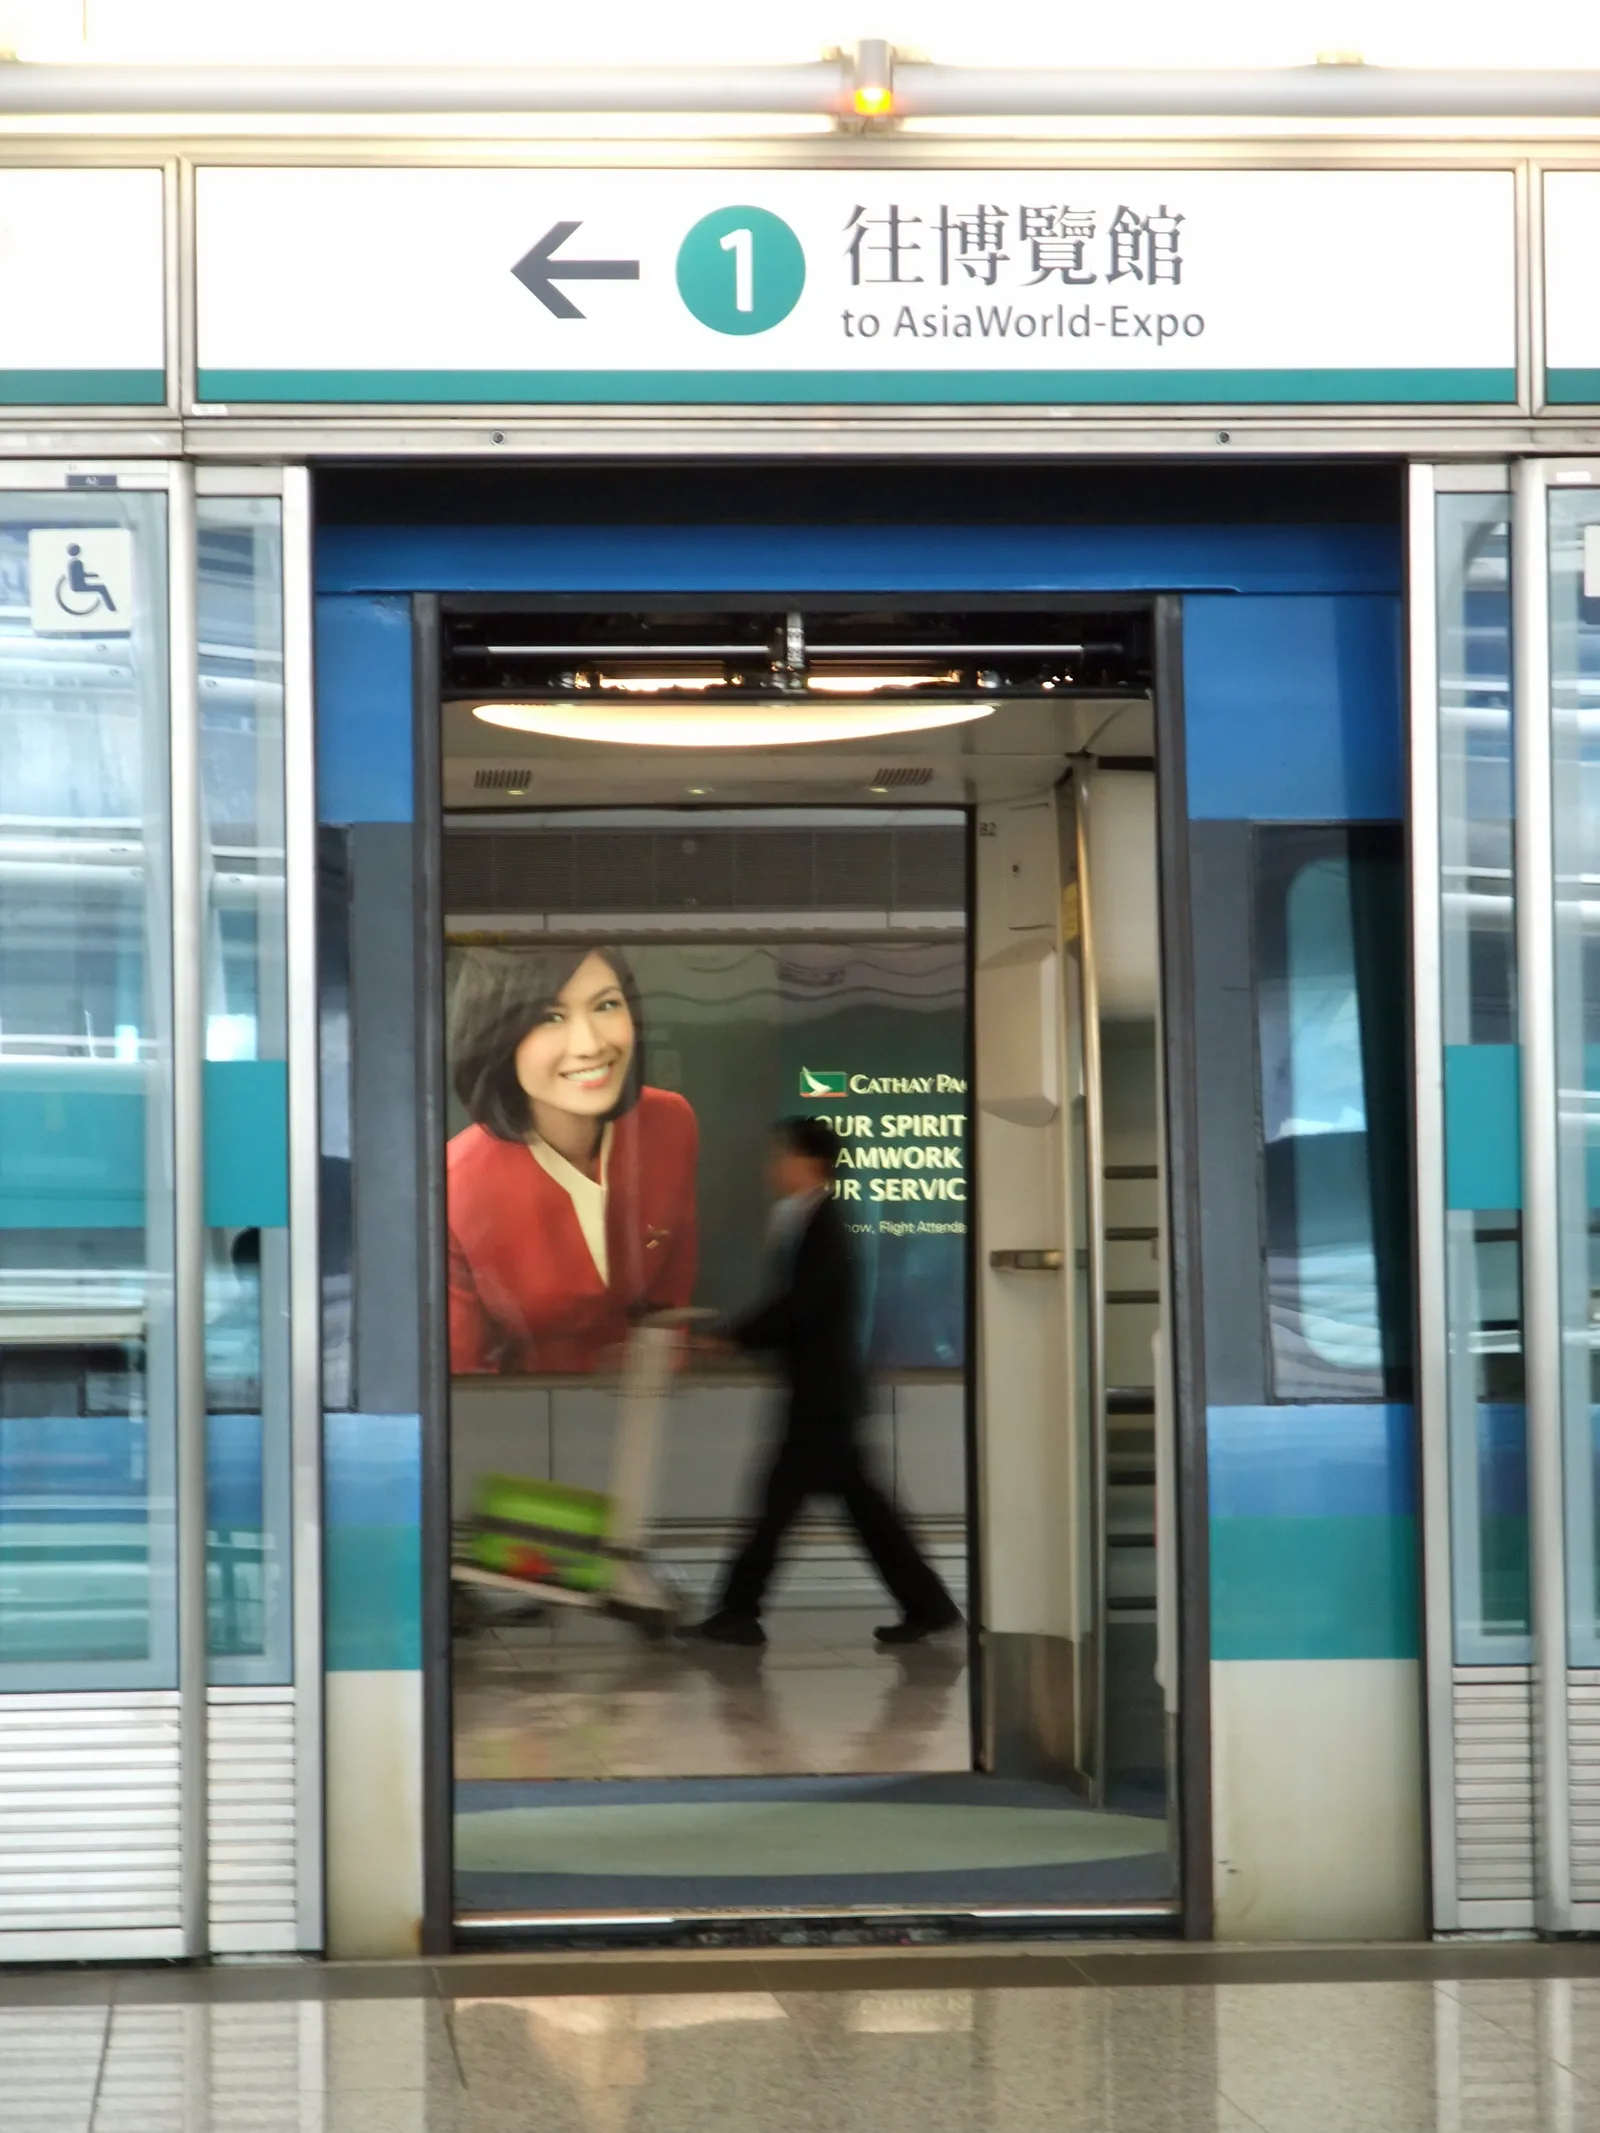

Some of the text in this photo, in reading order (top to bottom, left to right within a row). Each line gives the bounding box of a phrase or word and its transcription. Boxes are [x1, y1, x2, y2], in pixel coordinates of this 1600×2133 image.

[842, 204, 1186, 286] 往博覽館
[719, 228, 753, 312] 1
[841, 304, 1205, 346] to AsiaWorld-Expo
[849, 1074, 933, 1095] CATHAY
[880, 1114, 967, 1139] SPIRIT
[869, 1177, 967, 1202] SERVIC
[879, 1220, 916, 1237] Flight
